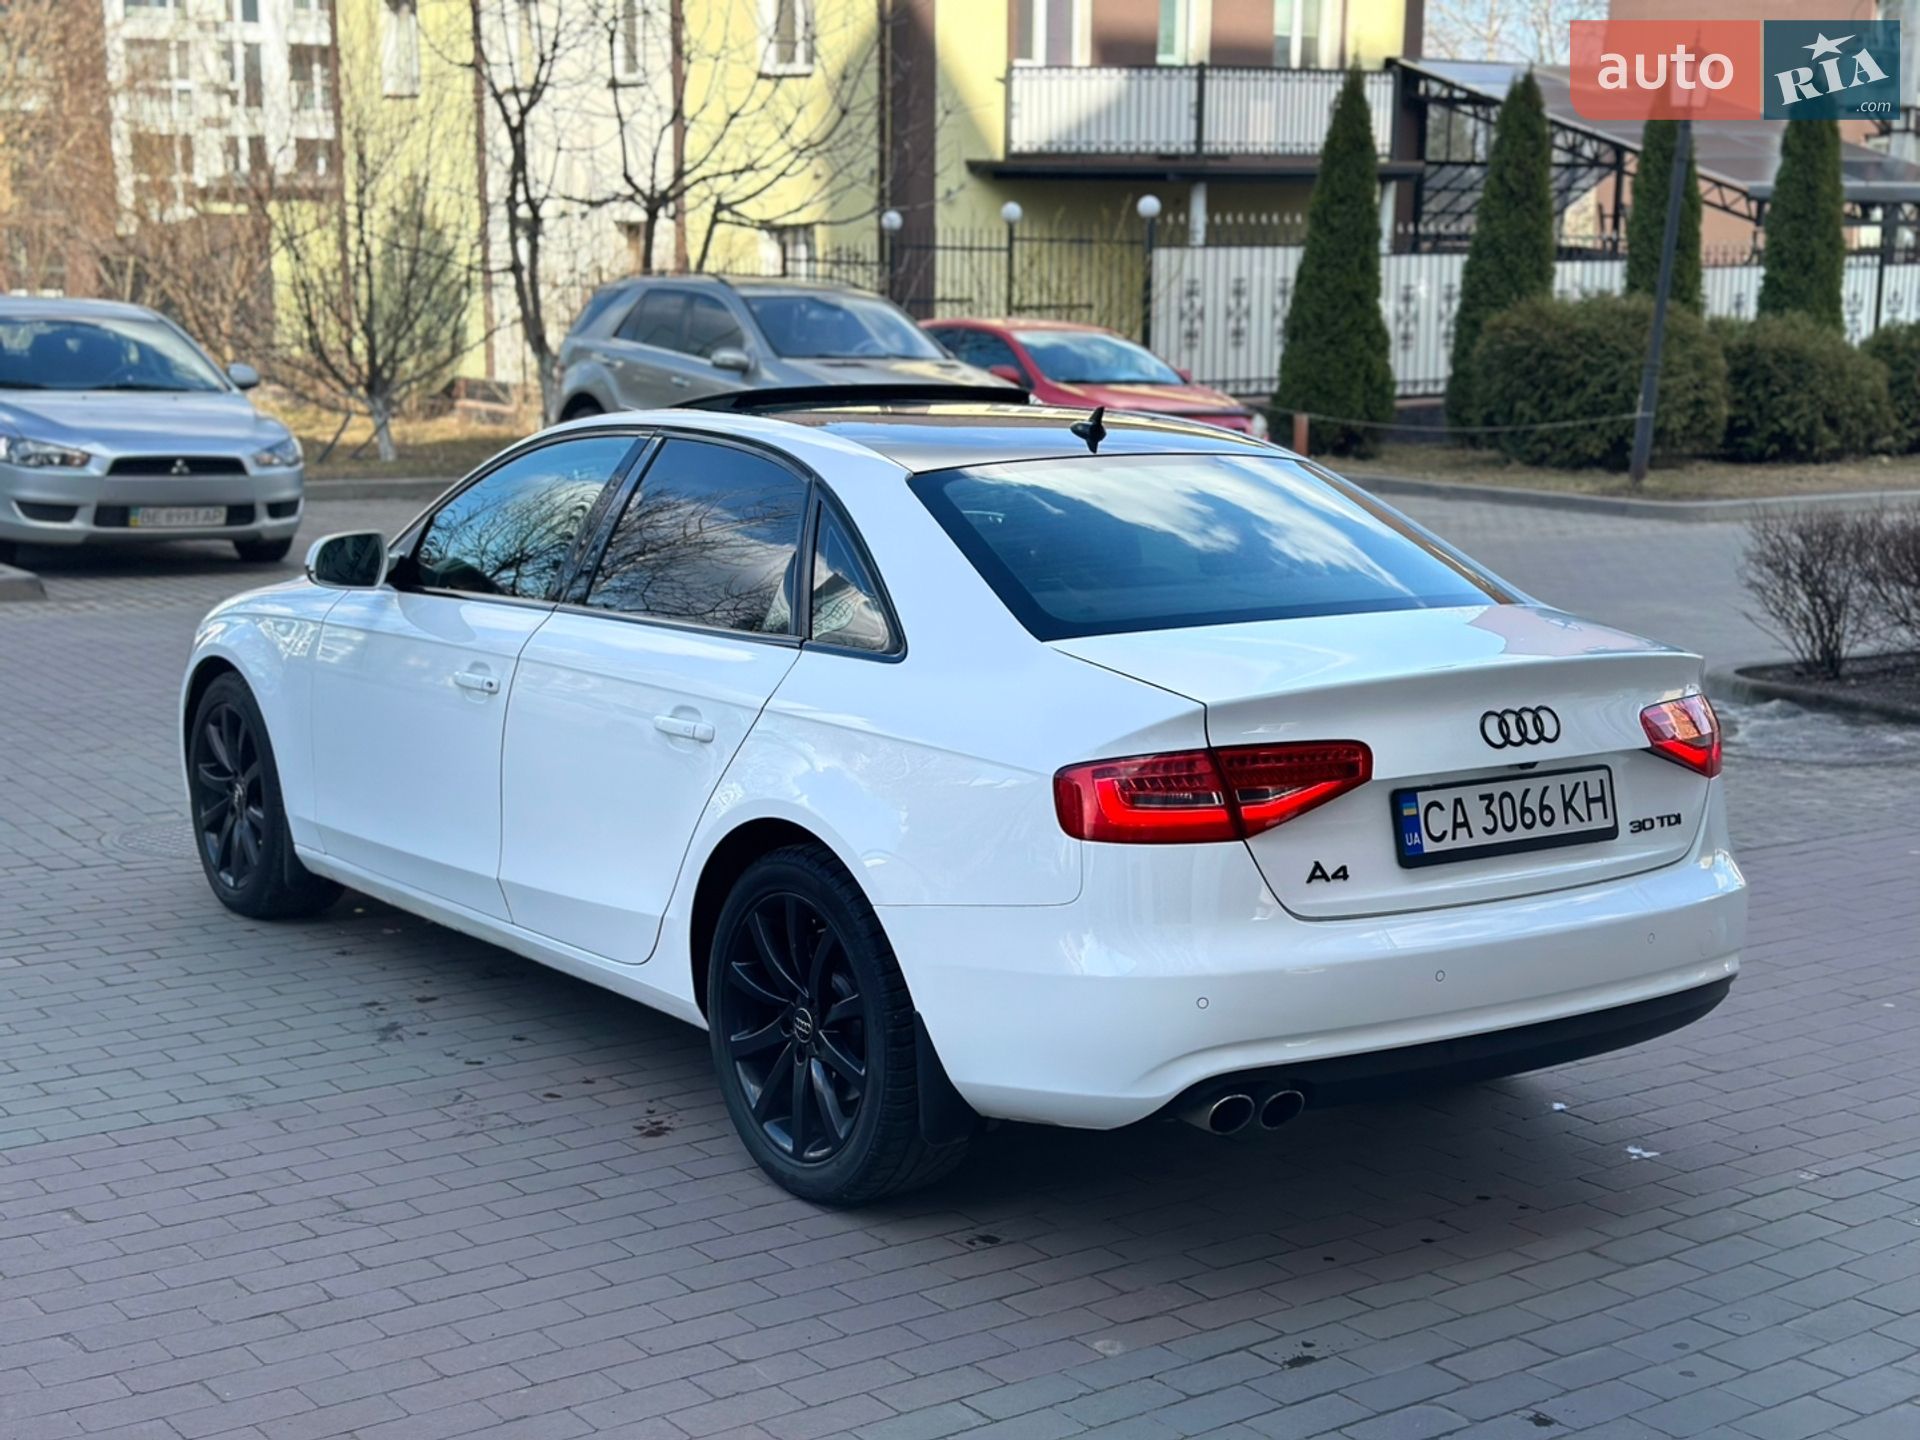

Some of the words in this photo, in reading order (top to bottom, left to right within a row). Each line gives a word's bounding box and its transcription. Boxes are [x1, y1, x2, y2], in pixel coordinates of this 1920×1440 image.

[1423, 797, 1473, 843] CA
[1478, 786, 1556, 836] 3066
[1560, 779, 1608, 825] KH
[1629, 818, 1655, 834] 30
[1657, 812, 1682, 828] TDI
[1405, 832, 1421, 846] UA
[1306, 860, 1349, 884] A4
